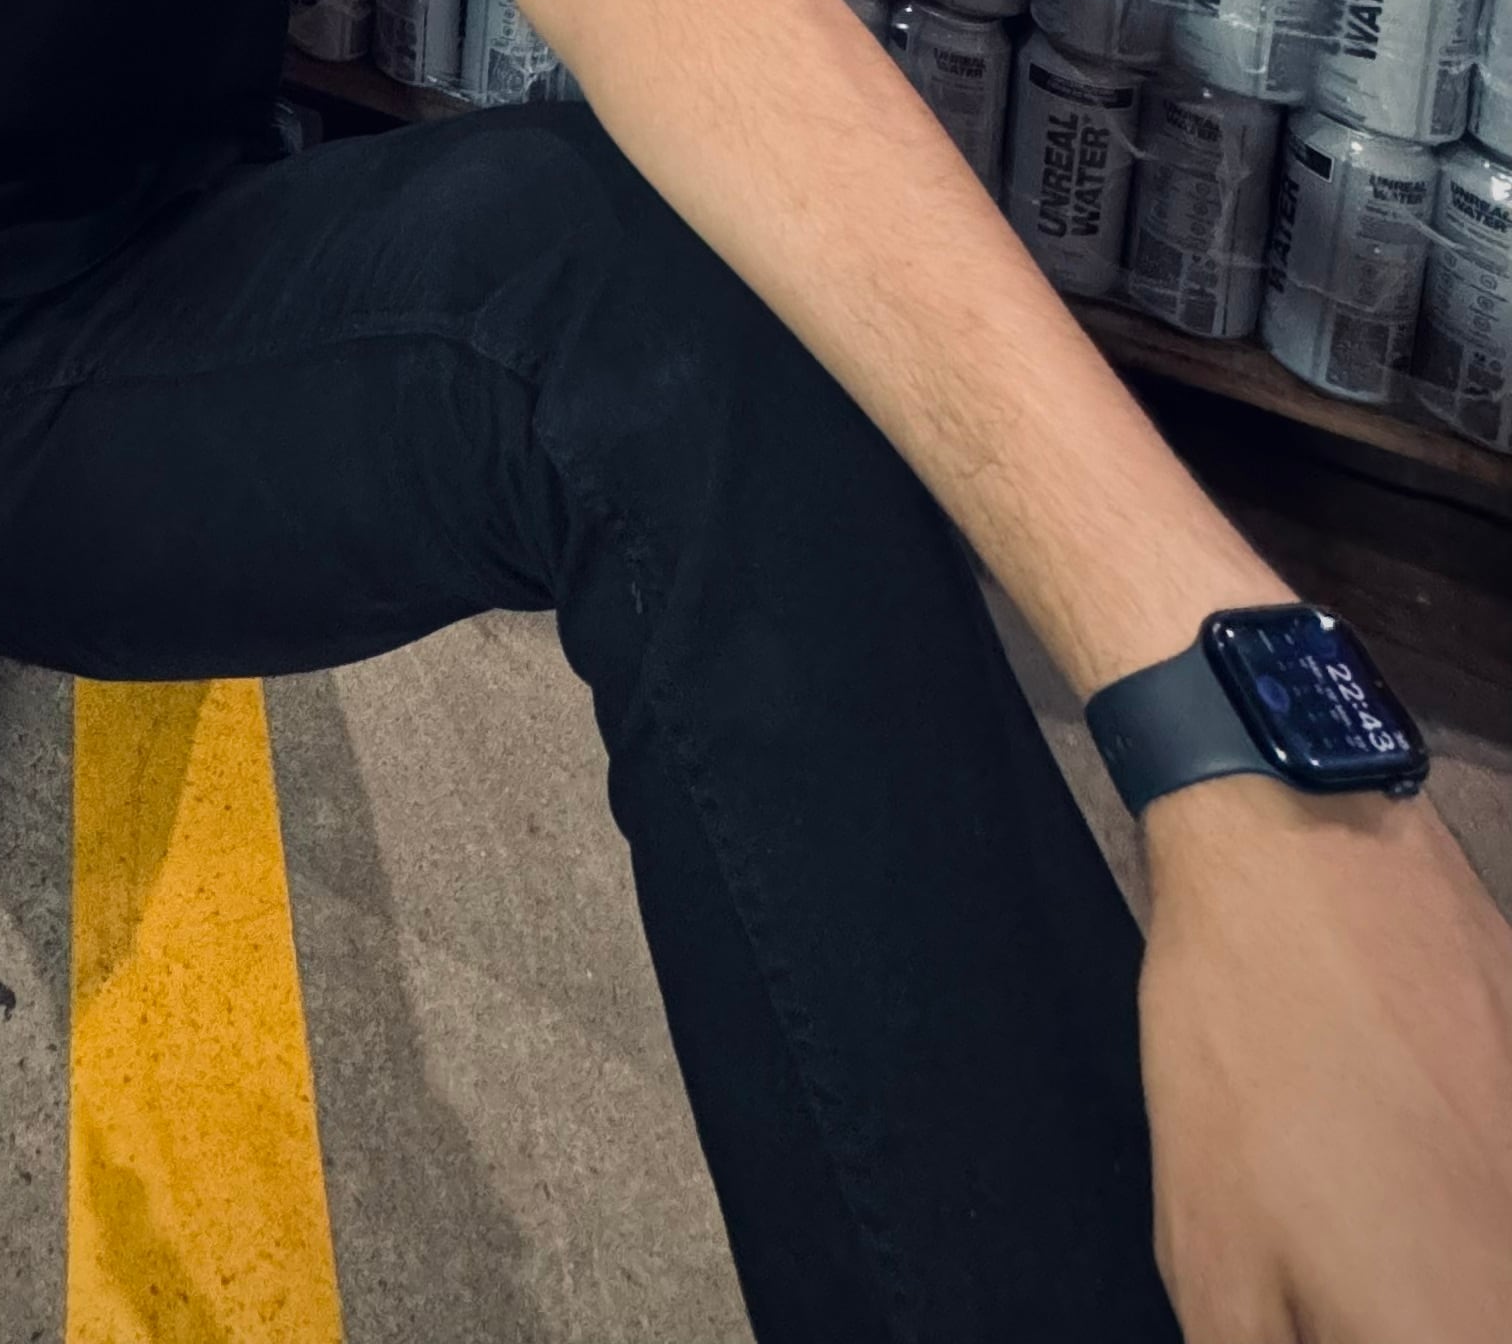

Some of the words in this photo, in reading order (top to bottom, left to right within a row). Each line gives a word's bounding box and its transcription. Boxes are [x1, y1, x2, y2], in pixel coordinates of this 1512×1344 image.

[1039, 113, 1079, 239] UNREAL
[1074, 125, 1110, 236] WATER
[1369, 176, 1428, 193] UNREAL
[1372, 189, 1426, 205] WATER
[1450, 182, 1511, 218] UNREAL
[1451, 198, 1511, 233] WATER
[1327, 663, 1395, 753] 22:43
